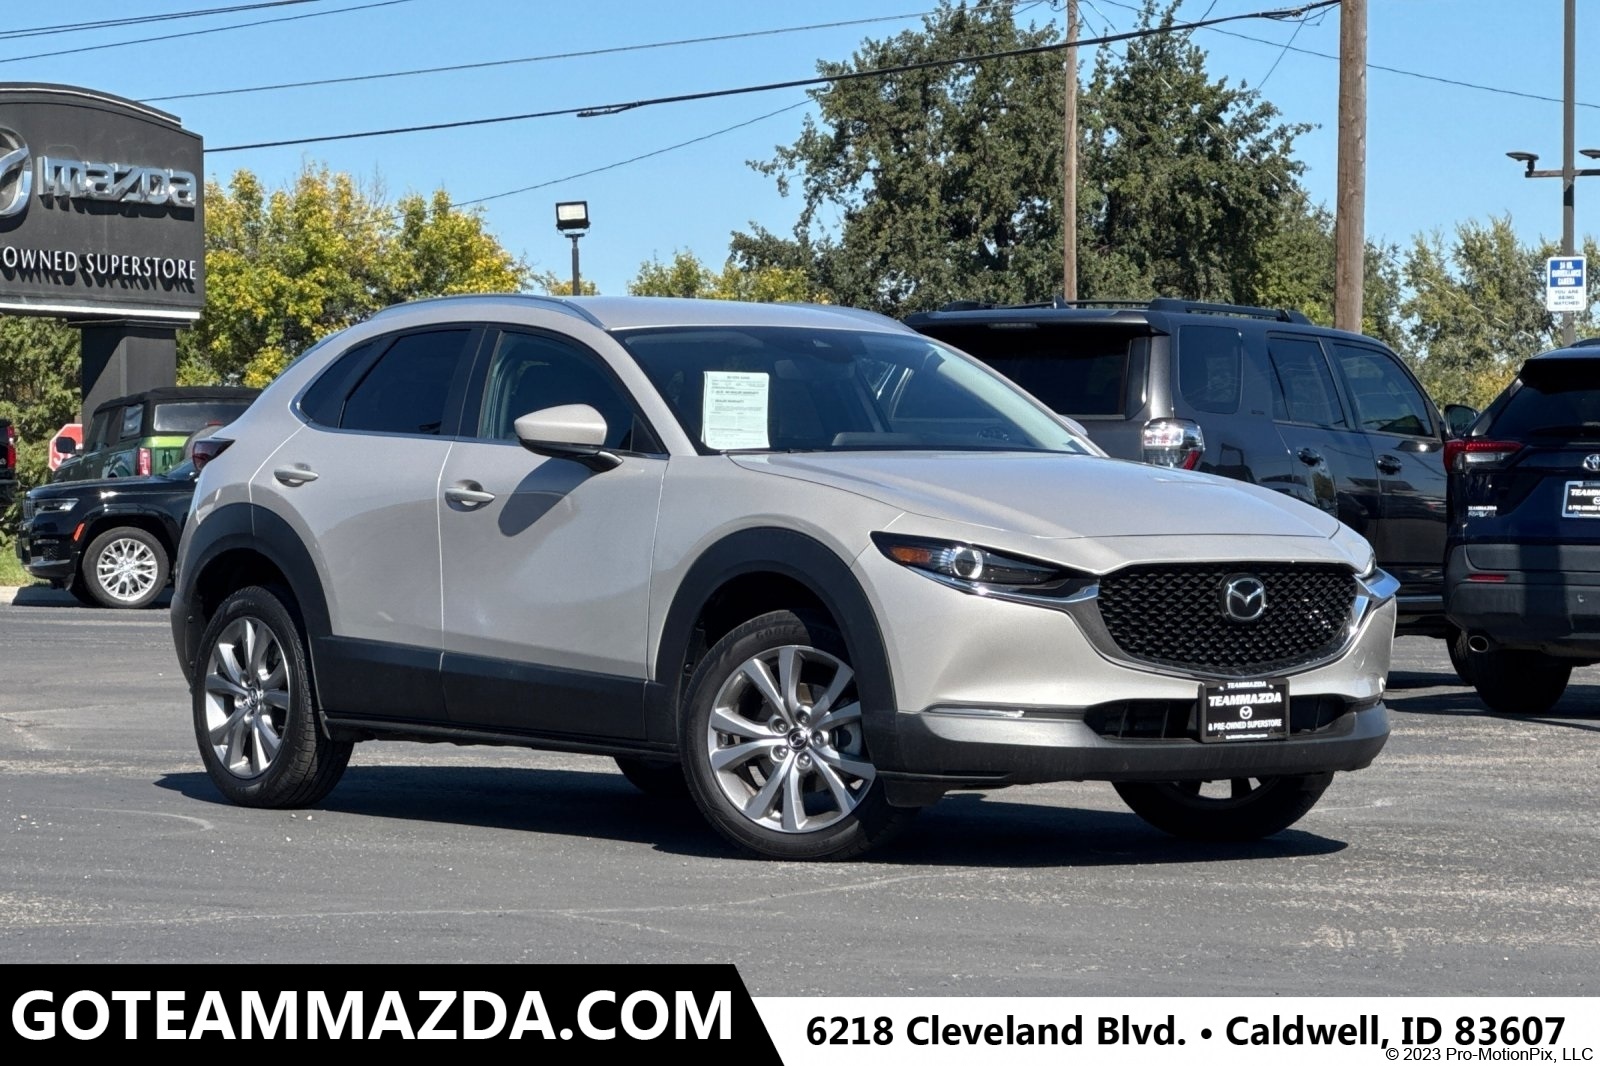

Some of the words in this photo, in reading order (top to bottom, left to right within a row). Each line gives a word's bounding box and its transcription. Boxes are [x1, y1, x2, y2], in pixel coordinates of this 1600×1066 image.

[37, 155, 197, 208] mazda
[3, 246, 78, 272] OWNED
[86, 253, 197, 280] SUPERSTORE
[1227, 681, 1267, 689] TEAMMAZDA
[1208, 692, 1282, 707] TEAMMAZDA
[1213, 721, 1247, 731] PRE-OWNED
[1247, 719, 1282, 729] SUPERSTORE
